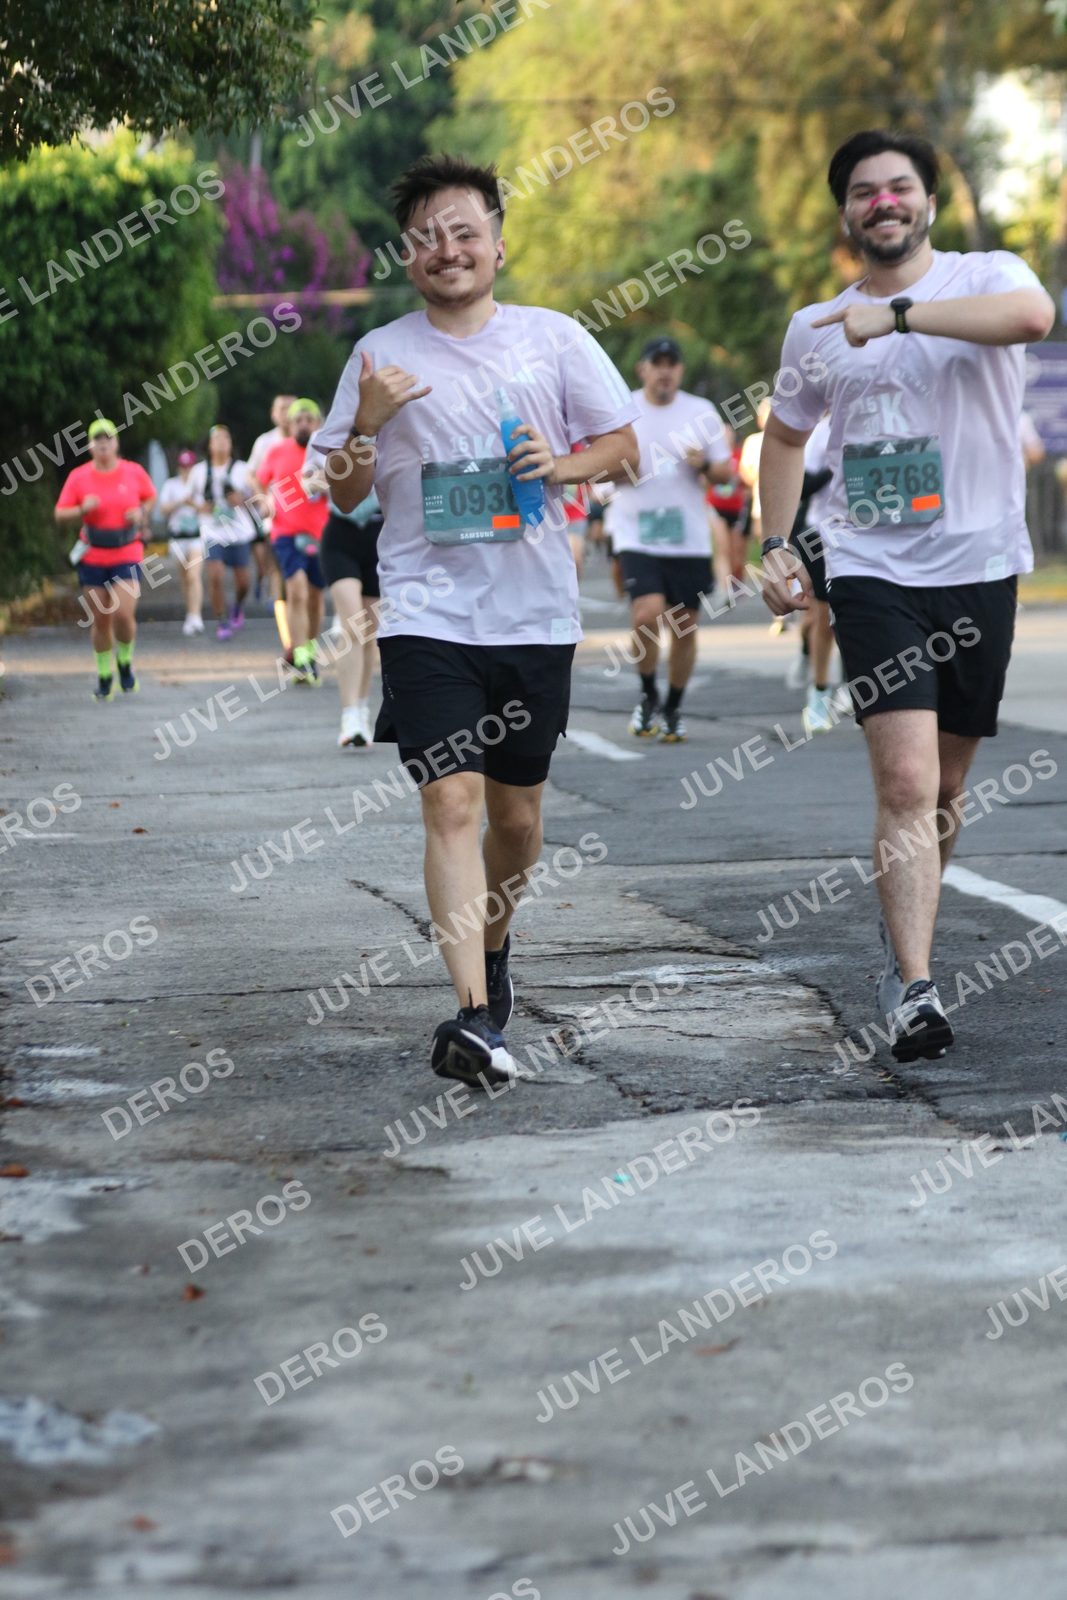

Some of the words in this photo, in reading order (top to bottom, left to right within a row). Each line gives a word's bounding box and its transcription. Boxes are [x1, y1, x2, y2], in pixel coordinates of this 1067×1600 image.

[879, 390, 910, 433] K
[868, 462, 938, 496] 3768
[460, 531, 494, 540] SAMSUNG
